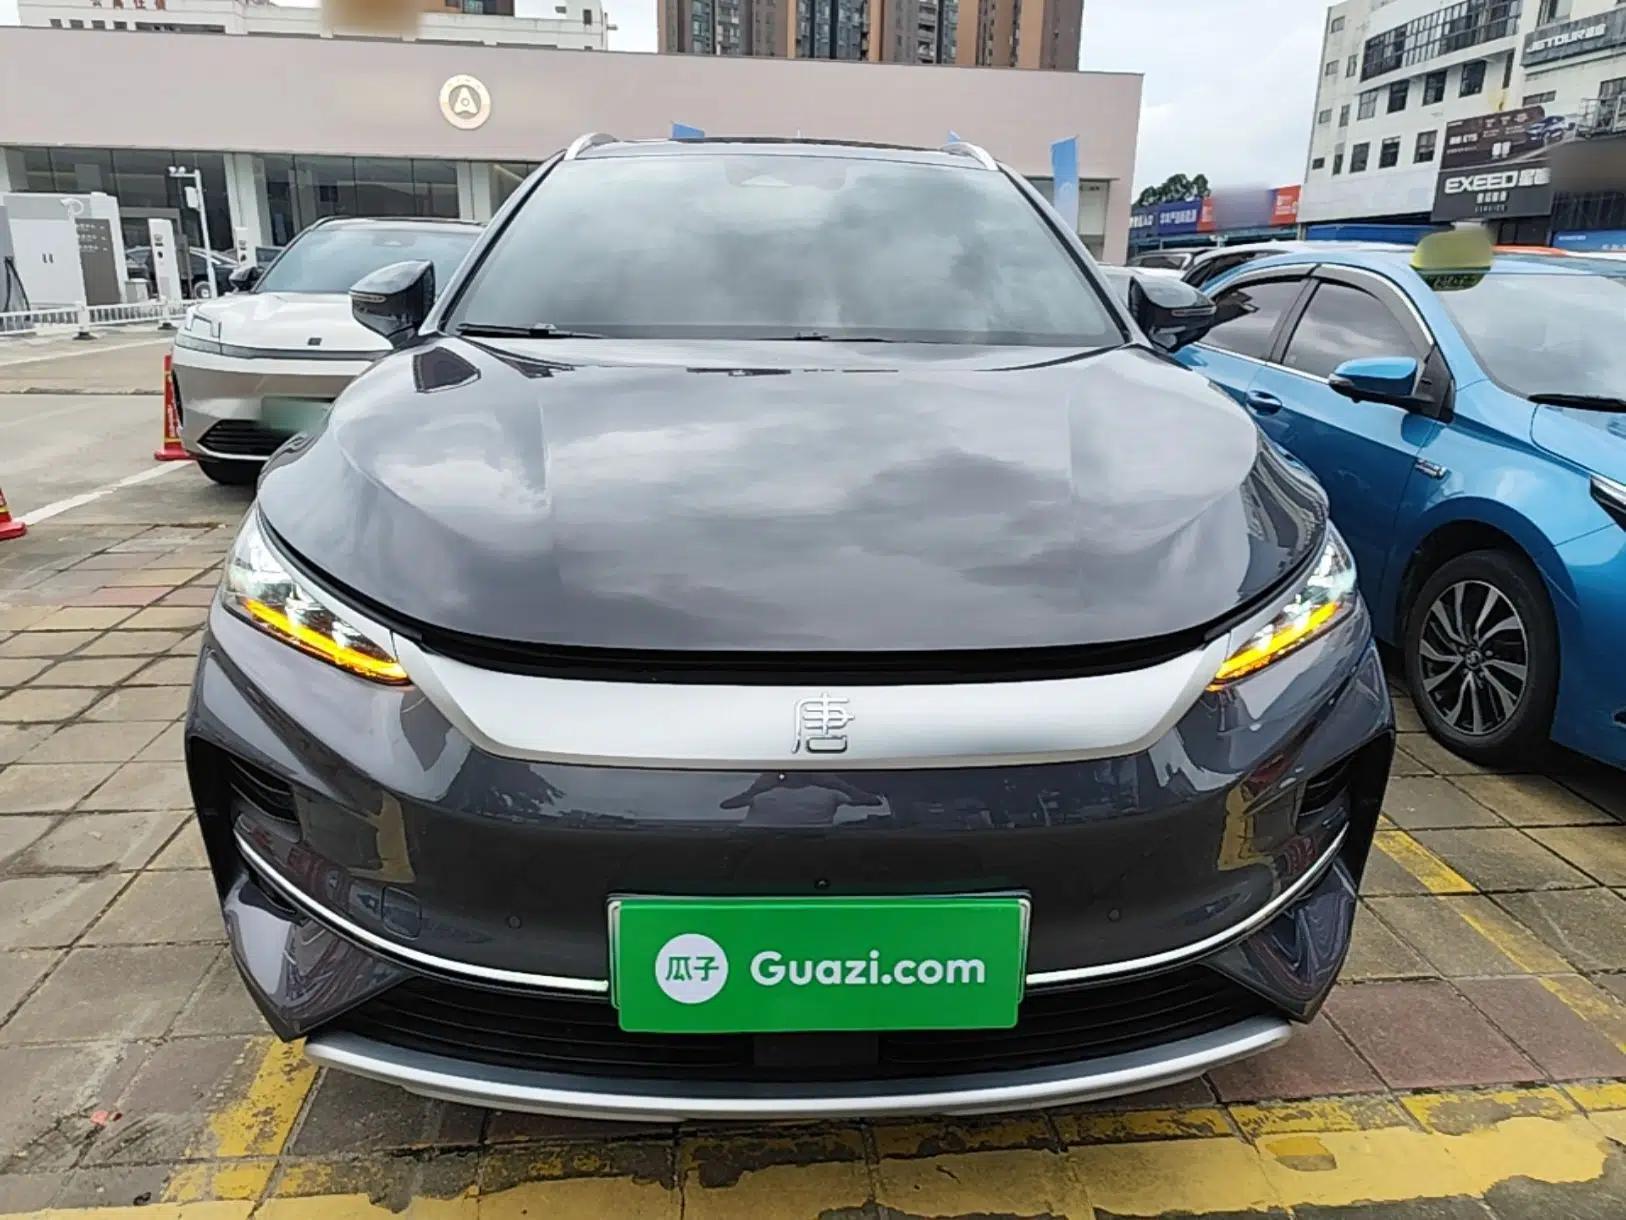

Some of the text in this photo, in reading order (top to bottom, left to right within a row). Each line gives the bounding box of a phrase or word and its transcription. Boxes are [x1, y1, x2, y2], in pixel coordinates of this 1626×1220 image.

[1526, 29, 1585, 53] JETOUR
[1444, 170, 1519, 194] EXEED
[791, 692, 855, 755] 唐
